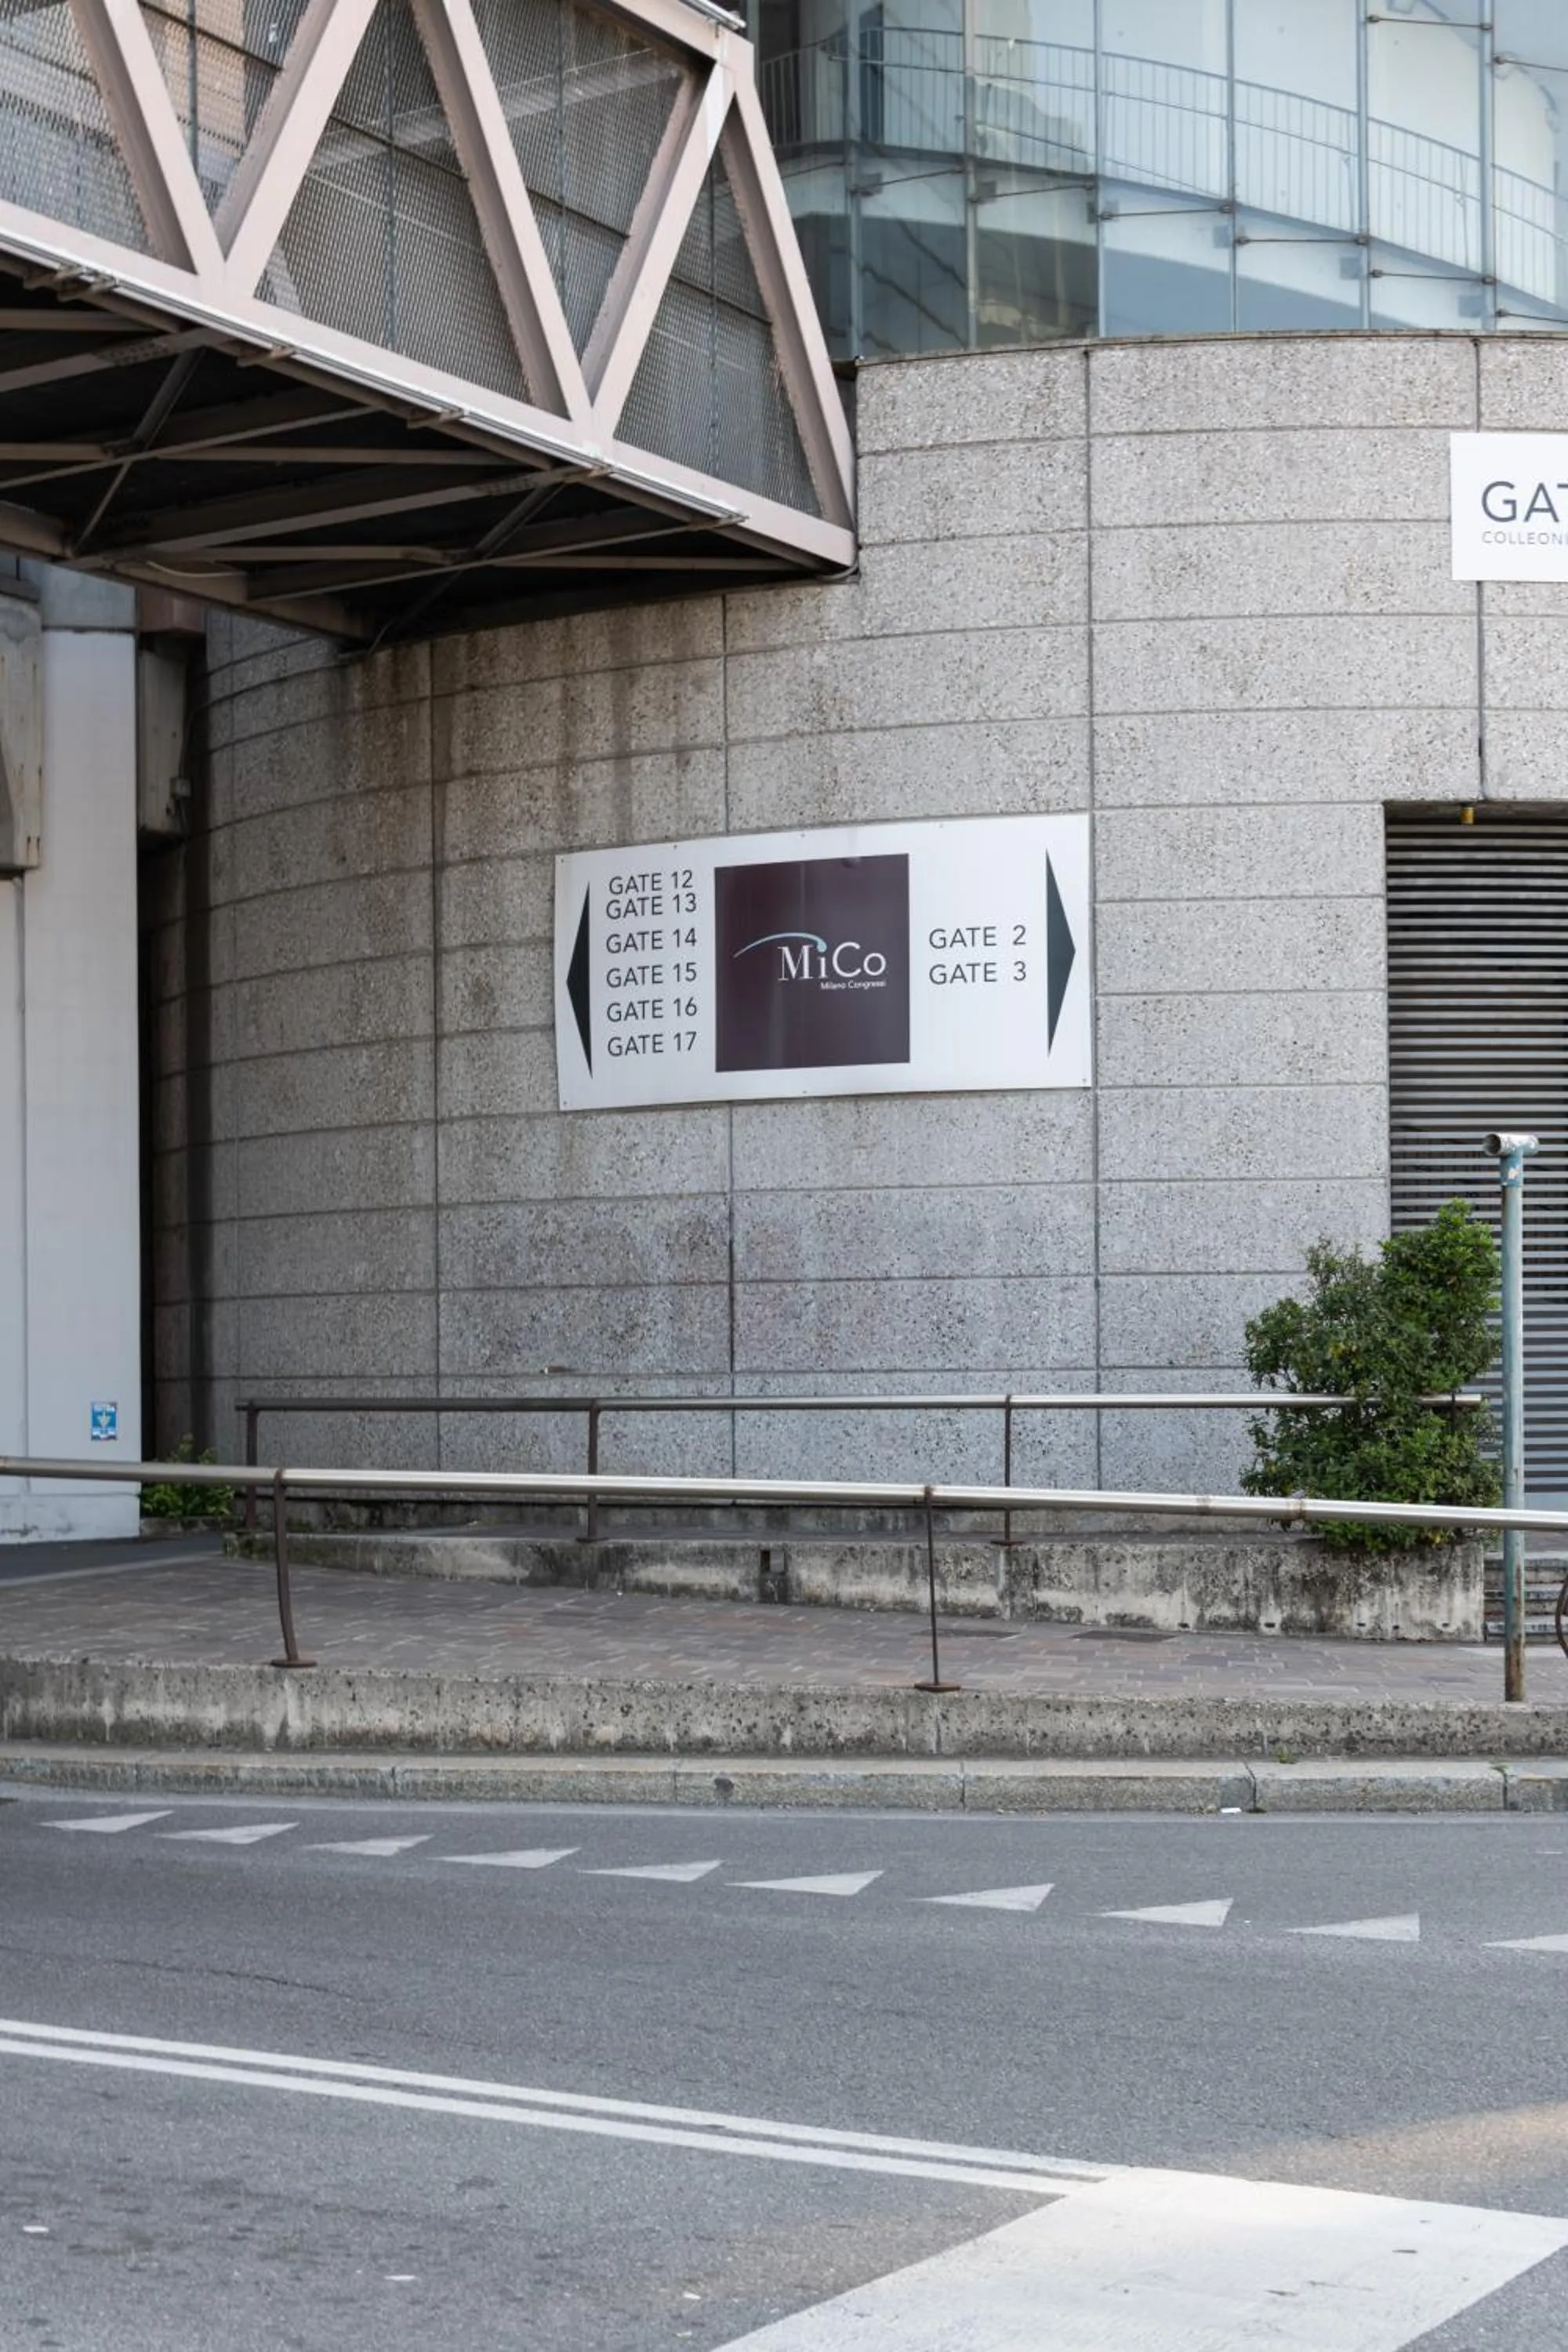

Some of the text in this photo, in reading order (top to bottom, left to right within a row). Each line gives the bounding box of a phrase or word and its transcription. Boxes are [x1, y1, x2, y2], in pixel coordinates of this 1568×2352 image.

[608, 869, 693, 895] GATE 12
[606, 893, 697, 920] GATE 13
[606, 927, 697, 953] GATE 14
[929, 924, 1026, 949] GATE 2
[777, 941, 886, 981] MiCo
[929, 960, 1026, 985] GATE 3
[606, 962, 697, 988] GATE 15
[606, 996, 697, 1022] GATE 16
[608, 1031, 697, 1057] GATE 17
